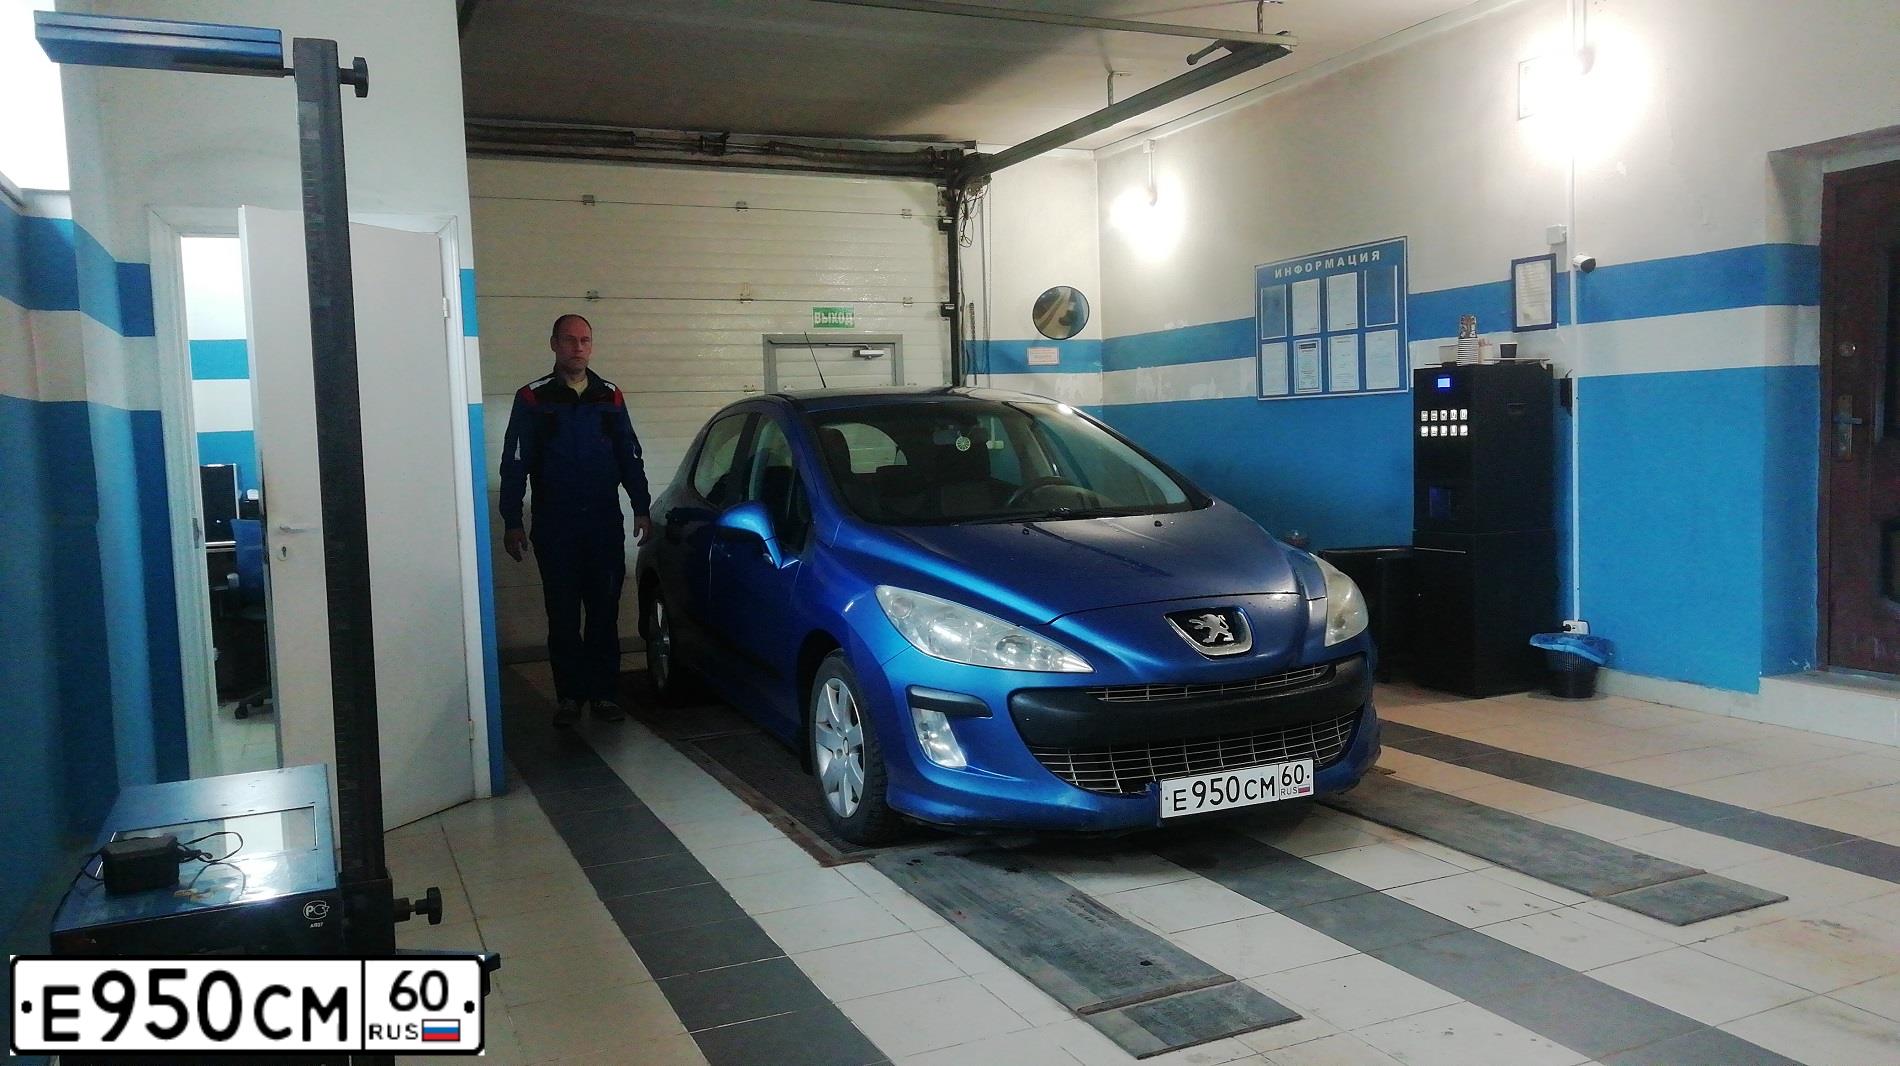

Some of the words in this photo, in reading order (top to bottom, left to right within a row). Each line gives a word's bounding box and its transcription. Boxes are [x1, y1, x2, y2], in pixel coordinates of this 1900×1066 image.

[1275, 250, 1380, 278] ИНФОРМАЦИЯ
[814, 311, 853, 326] ВЫХОД
[1281, 764, 1304, 786] 60
[1281, 787, 1297, 796] RUS
